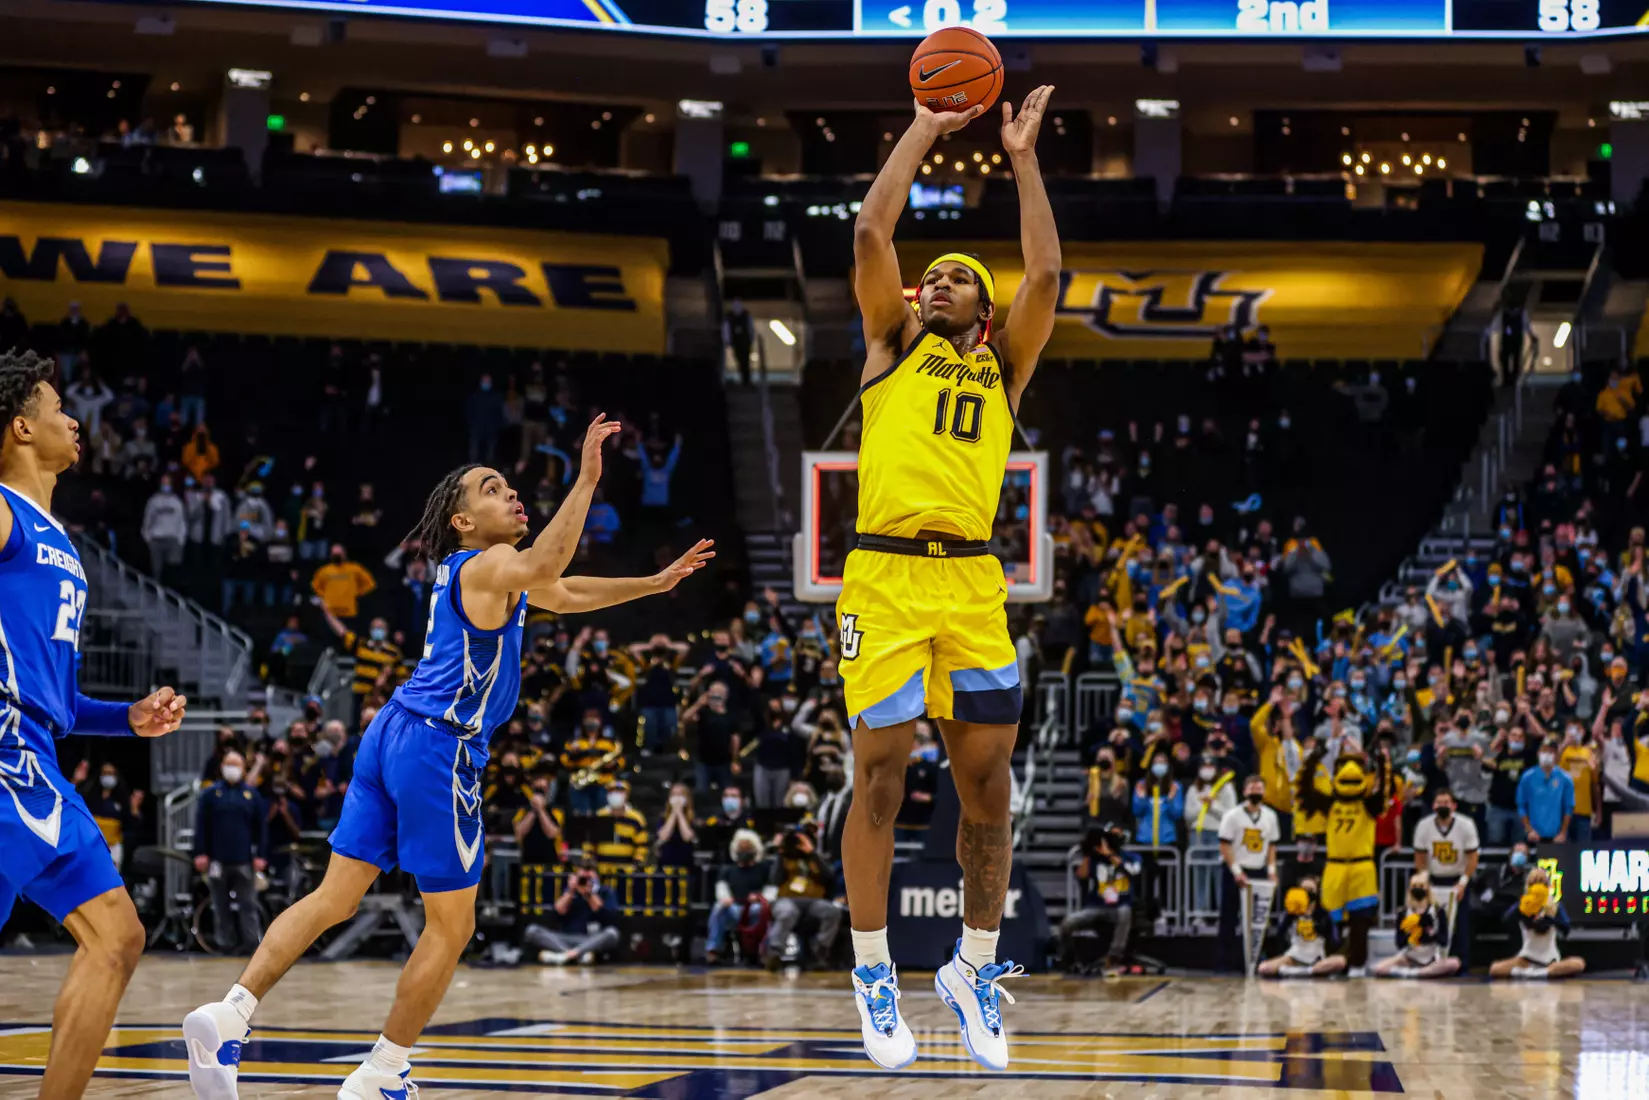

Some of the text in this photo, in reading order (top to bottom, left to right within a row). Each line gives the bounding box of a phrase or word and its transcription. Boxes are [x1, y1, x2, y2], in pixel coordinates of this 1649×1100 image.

[705, 0, 769, 32] 58
[1236, 0, 1329, 34] 2nd
[1538, 0, 1600, 32] 58
[926, 91, 968, 108] ELITE
[0, 235, 638, 313] WE ARE
[932, 388, 986, 443] 10
[928, 541, 946, 556] AL
[901, 878, 1022, 918] meir
